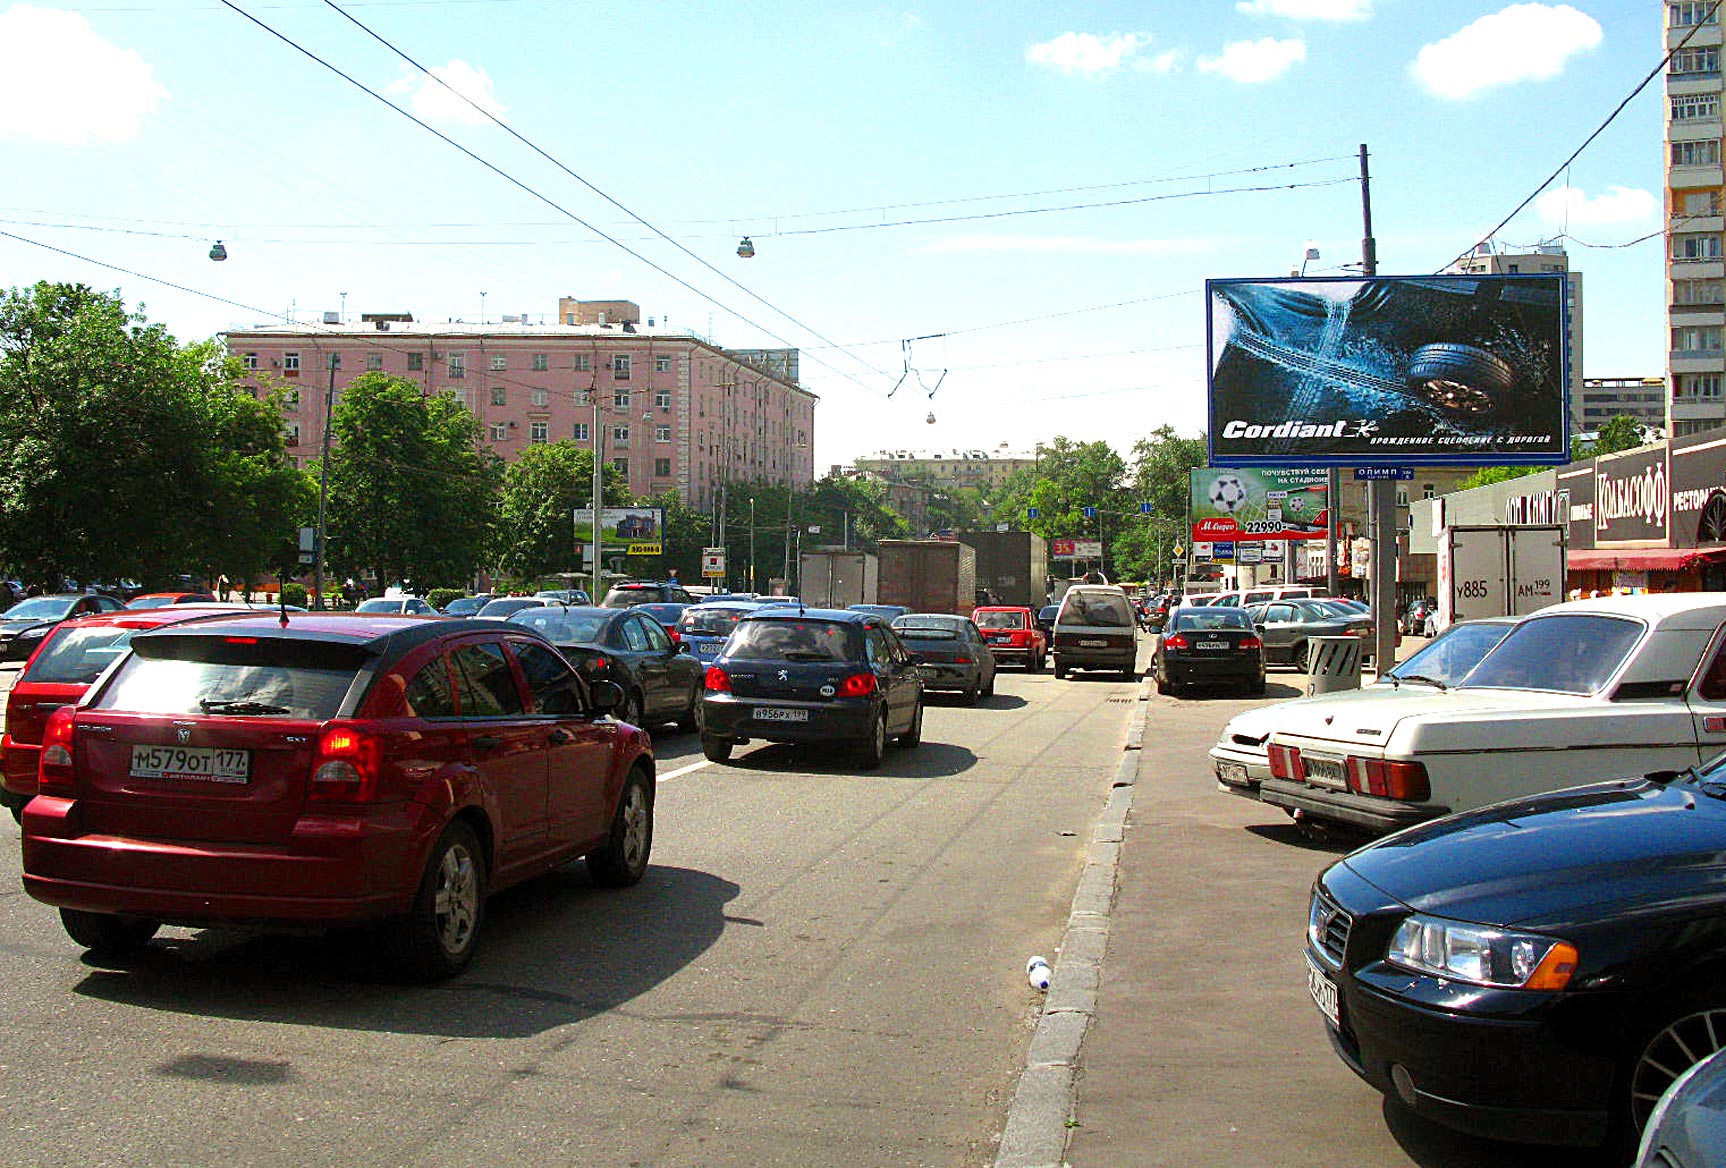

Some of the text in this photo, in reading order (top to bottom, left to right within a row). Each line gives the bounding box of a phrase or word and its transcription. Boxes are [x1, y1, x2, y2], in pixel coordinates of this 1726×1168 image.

[1222, 420, 1347, 439] Cordiant
[1370, 437, 1434, 446] ВРОЖДЕННОЕ
[1507, 435, 1551, 445] ДОРОГОЙ
[1261, 468, 1310, 477] ПОЧУВСТВУЙ
[1518, 579, 1550, 597] АМ 199
[137, 748, 244, 772] М579ОТ 177
